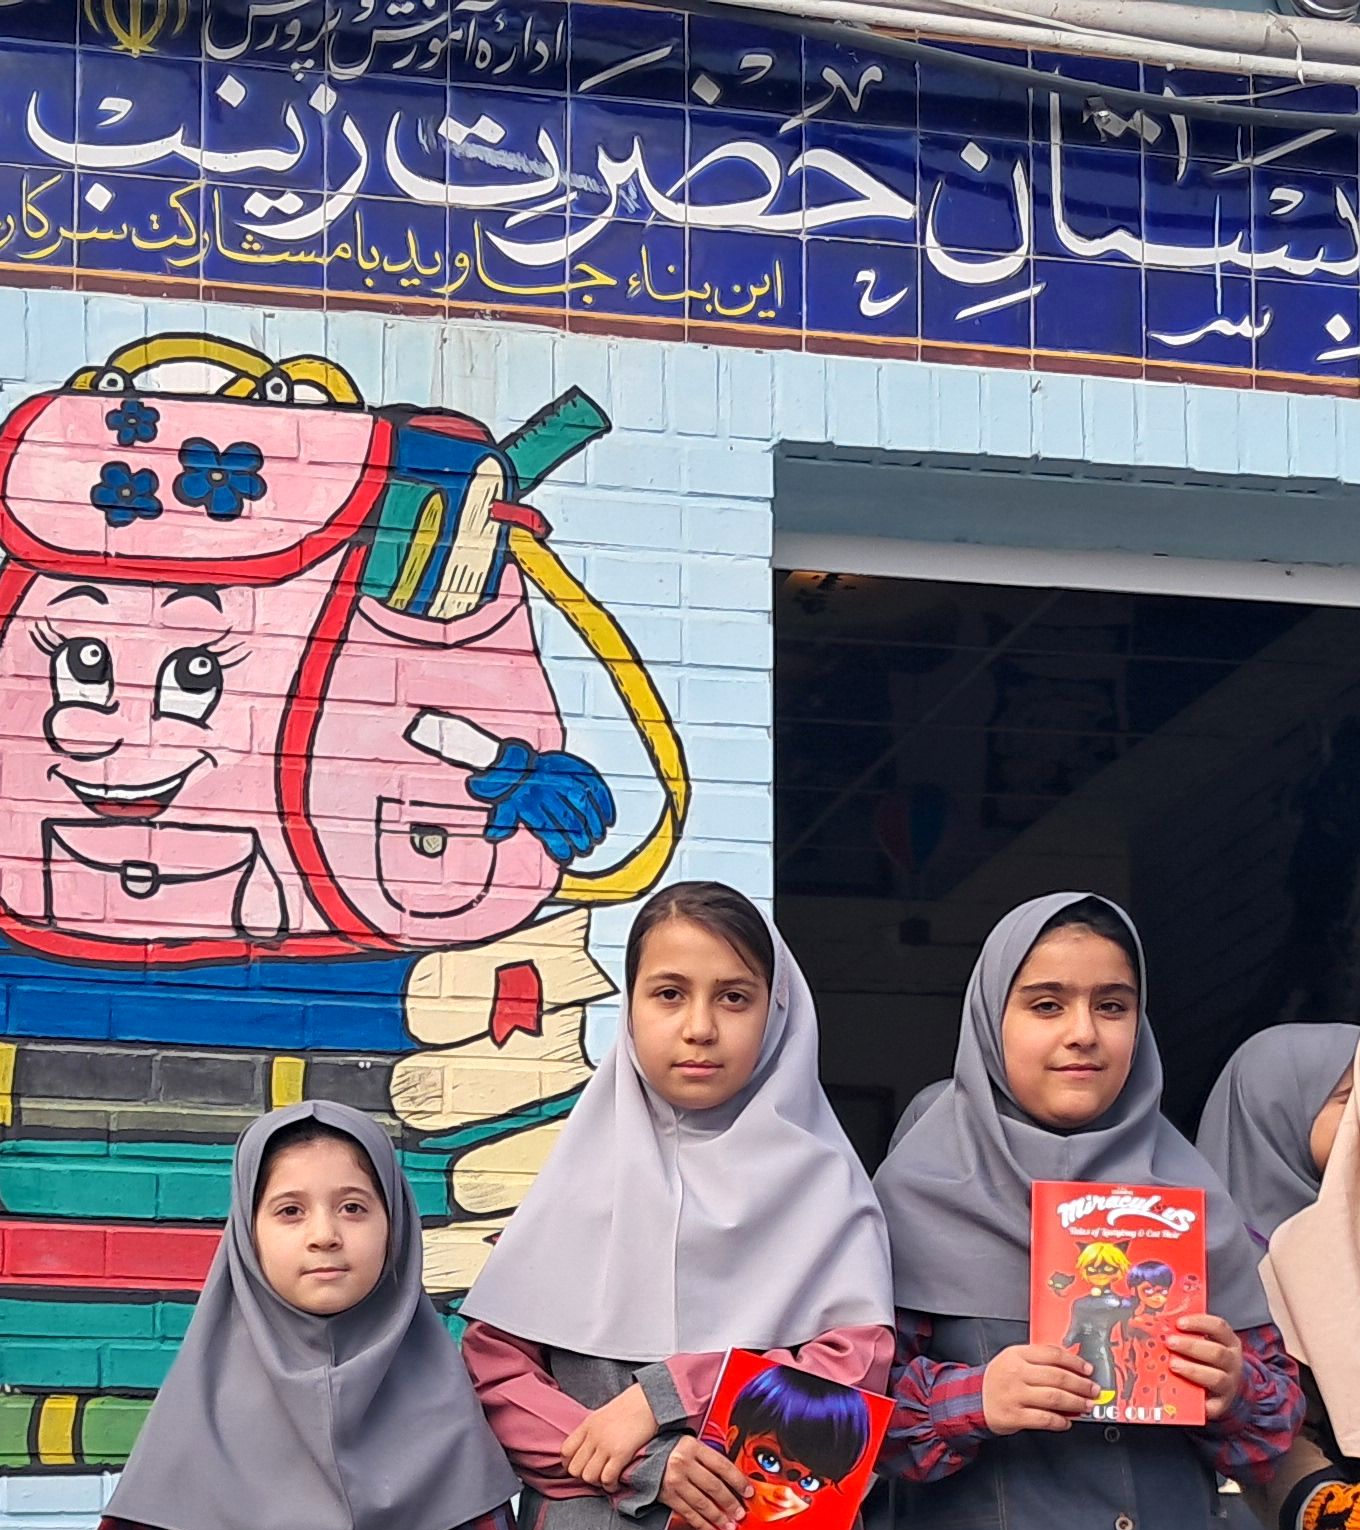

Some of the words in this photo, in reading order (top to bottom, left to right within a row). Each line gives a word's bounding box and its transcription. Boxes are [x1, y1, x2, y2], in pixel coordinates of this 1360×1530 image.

[26, 73, 367, 242] زینب
[383, 72, 916, 267] حضرت
[131, 178, 353, 267] مشارکت
[353, 212, 380, 287] با
[384, 218, 618, 305] جاوید
[715, 259, 782, 318] این
[1092, 1404, 1120, 1420] UG
